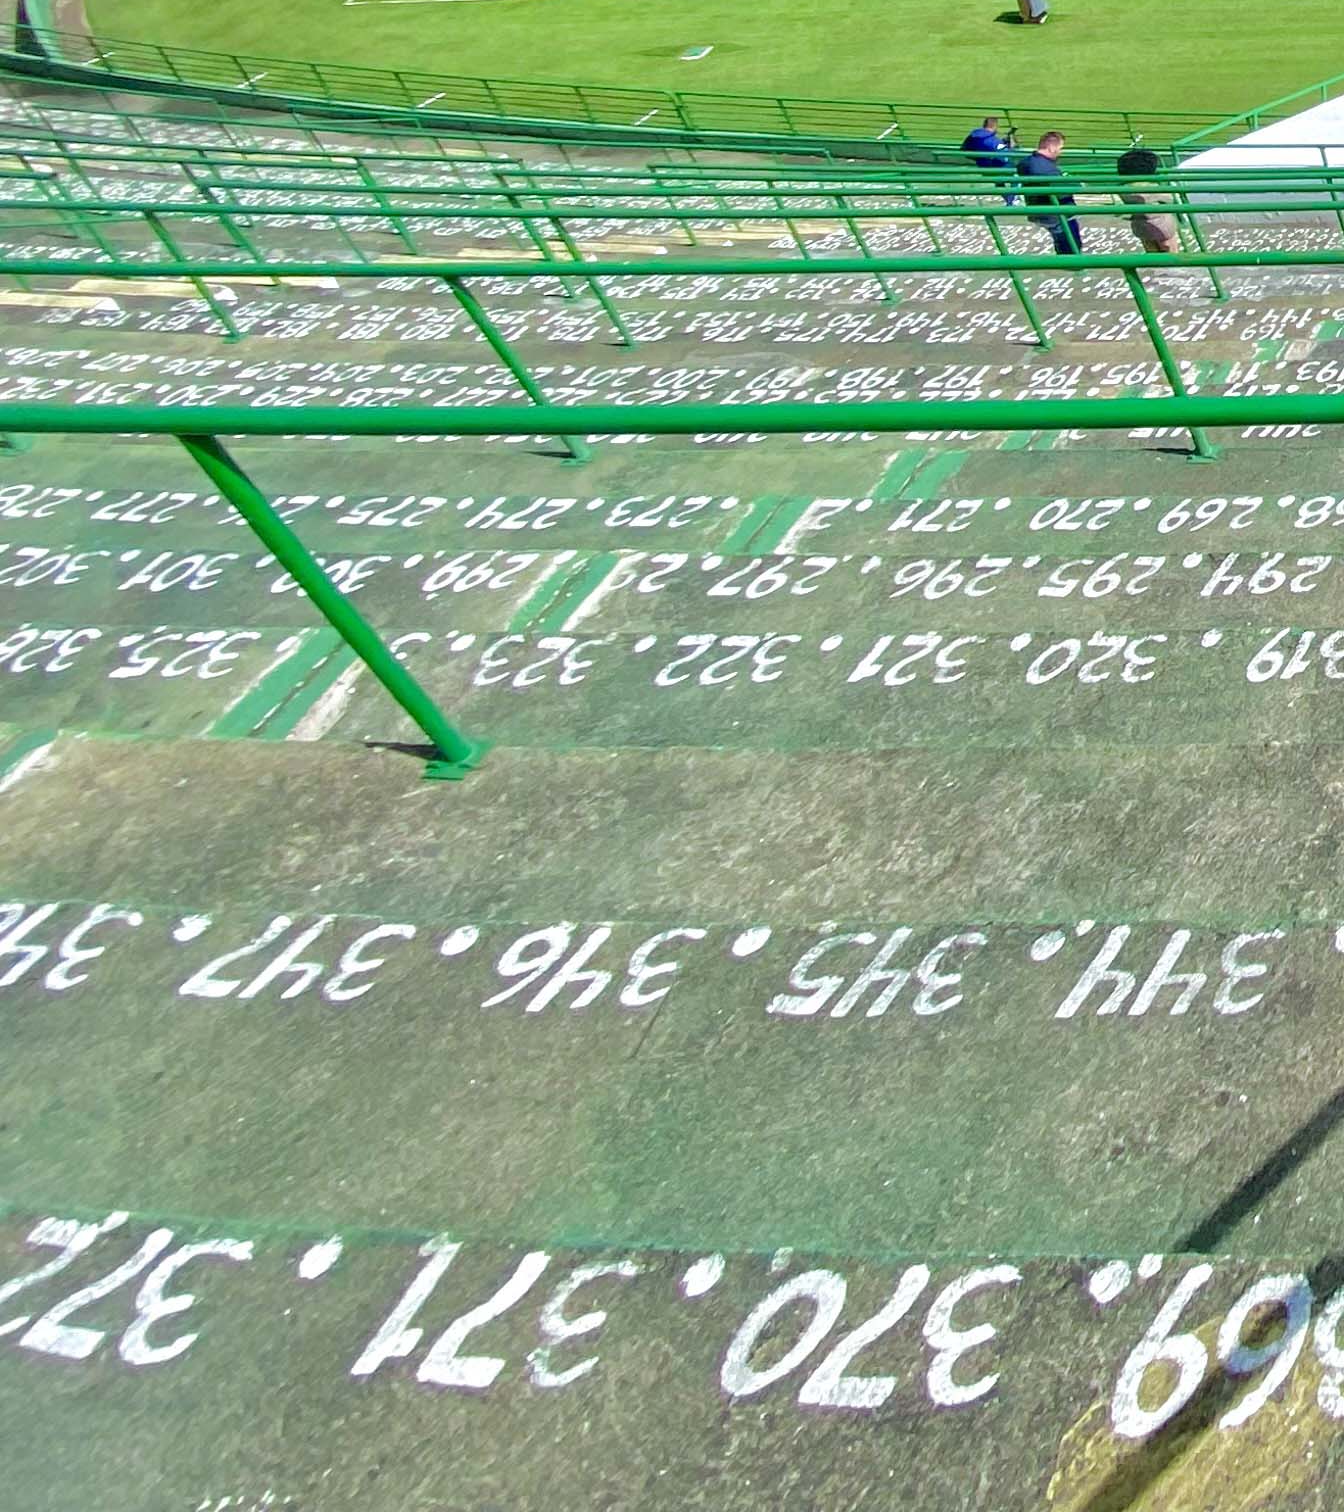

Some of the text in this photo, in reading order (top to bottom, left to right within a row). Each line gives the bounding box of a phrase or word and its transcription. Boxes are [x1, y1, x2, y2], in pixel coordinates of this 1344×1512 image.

[773, 323, 1287, 343] 169 173 175
[828, 308, 1313, 328] 144 145 149 150
[81, 353, 149, 372] 207
[159, 358, 225, 376] 206
[308, 363, 385, 383] 204
[400, 364, 468, 384] 203
[571, 366, 646, 386] 201
[653, 368, 730, 389] 200
[745, 367, 816, 389] 199
[837, 367, 904, 389] 198
[923, 365, 992, 388] 197
[1028, 365, 1083, 389] 196
[1100, 362, 1162, 385] 195
[158, 385, 242, 407] 230
[250, 386, 326, 407] 229
[340, 387, 414, 407] 228
[90, 492, 197, 524] 277
[337, 495, 447, 527] 275
[464, 496, 569, 530] 274
[604, 496, 712, 528] 273
[888, 498, 983, 532] 271
[1029, 498, 1123, 531] 270
[1157, 497, 1263, 533] 269
[119, 551, 238, 591] 301
[422, 550, 539, 595] 299
[707, 555, 837, 599] 297
[891, 556, 1012, 600] 296
[1038, 554, 1165, 599] 295
[1200, 552, 1332, 597] 294
[108, 632, 260, 679] 325
[473, 635, 602, 687] 323
[653, 633, 801, 687] 322
[848, 635, 986, 685] 321
[1026, 634, 1167, 685] 320
[178, 914, 416, 1001] 347
[481, 921, 707, 1013] 346
[767, 928, 987, 1018] 345
[1054, 924, 1285, 1019] 344
[350, 1234, 637, 1389] 371
[720, 1263, 1022, 1408] 370
